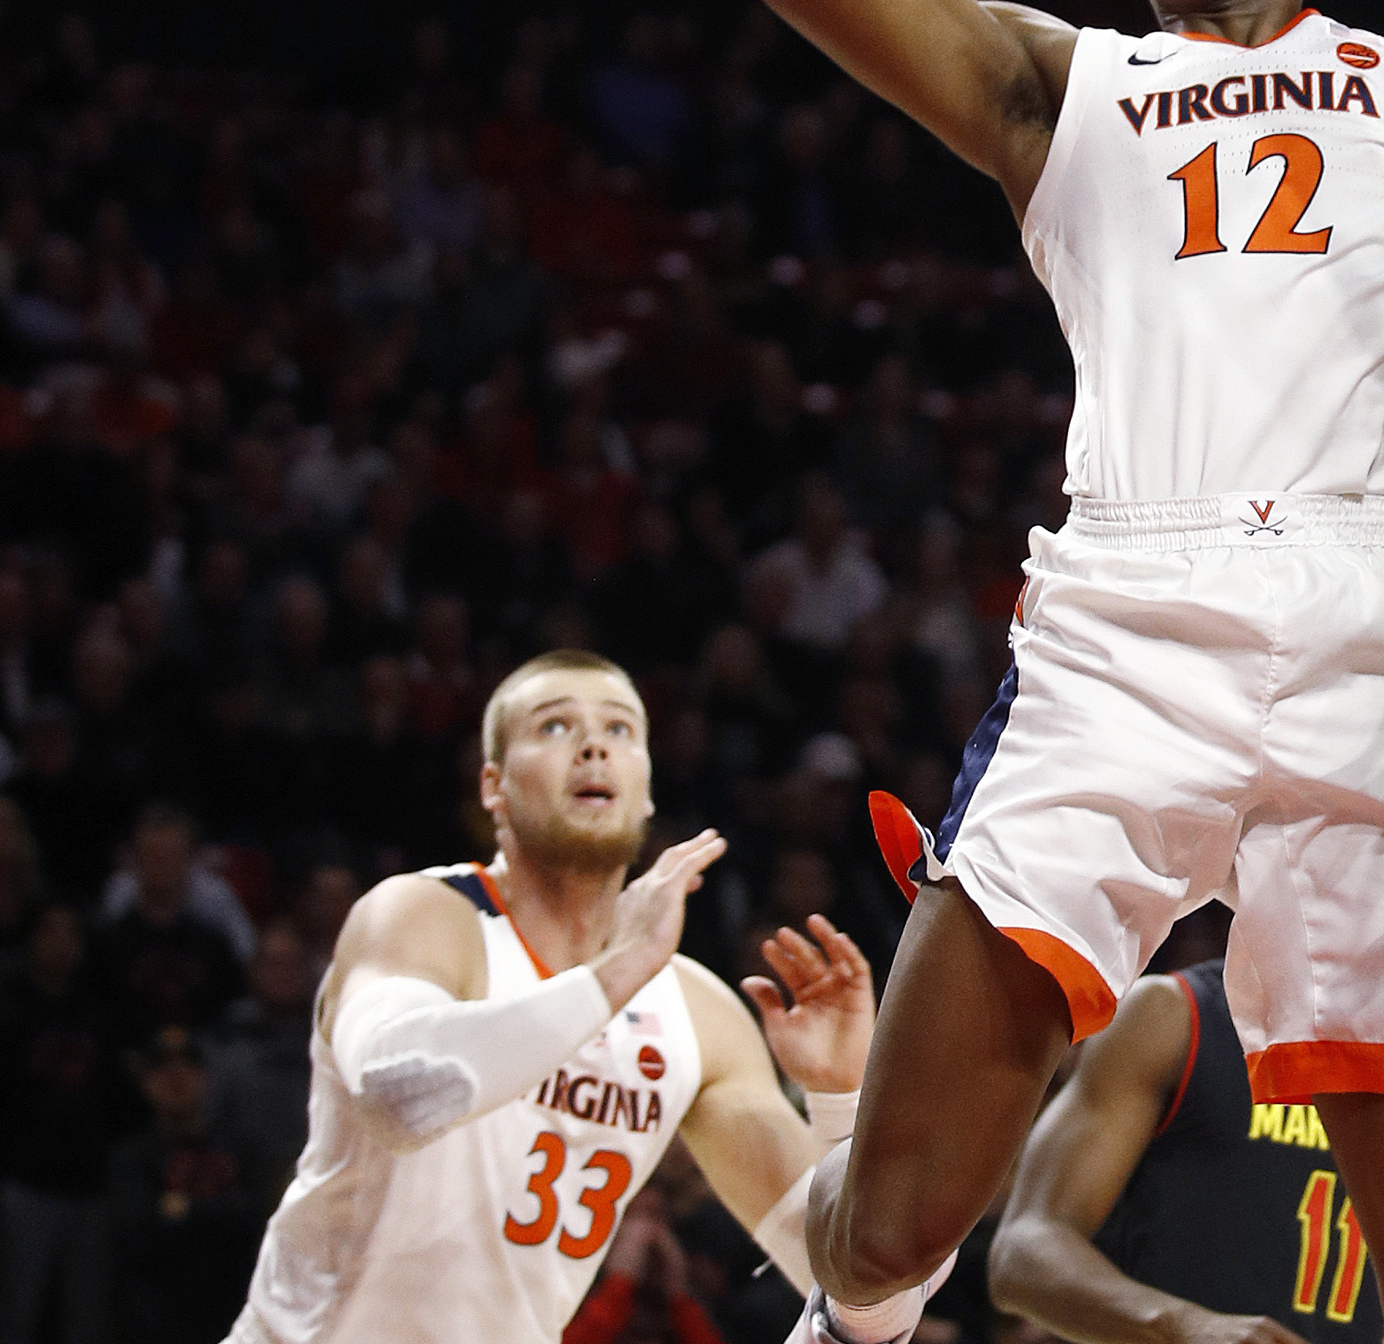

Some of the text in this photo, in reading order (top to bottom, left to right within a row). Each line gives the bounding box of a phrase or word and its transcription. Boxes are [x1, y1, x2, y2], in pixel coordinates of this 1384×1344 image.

[1117, 70, 1381, 137] VIRGINIA
[1166, 132, 1334, 260] 12
[503, 1130, 633, 1260] 33
[1293, 1169, 1368, 1324] 11
